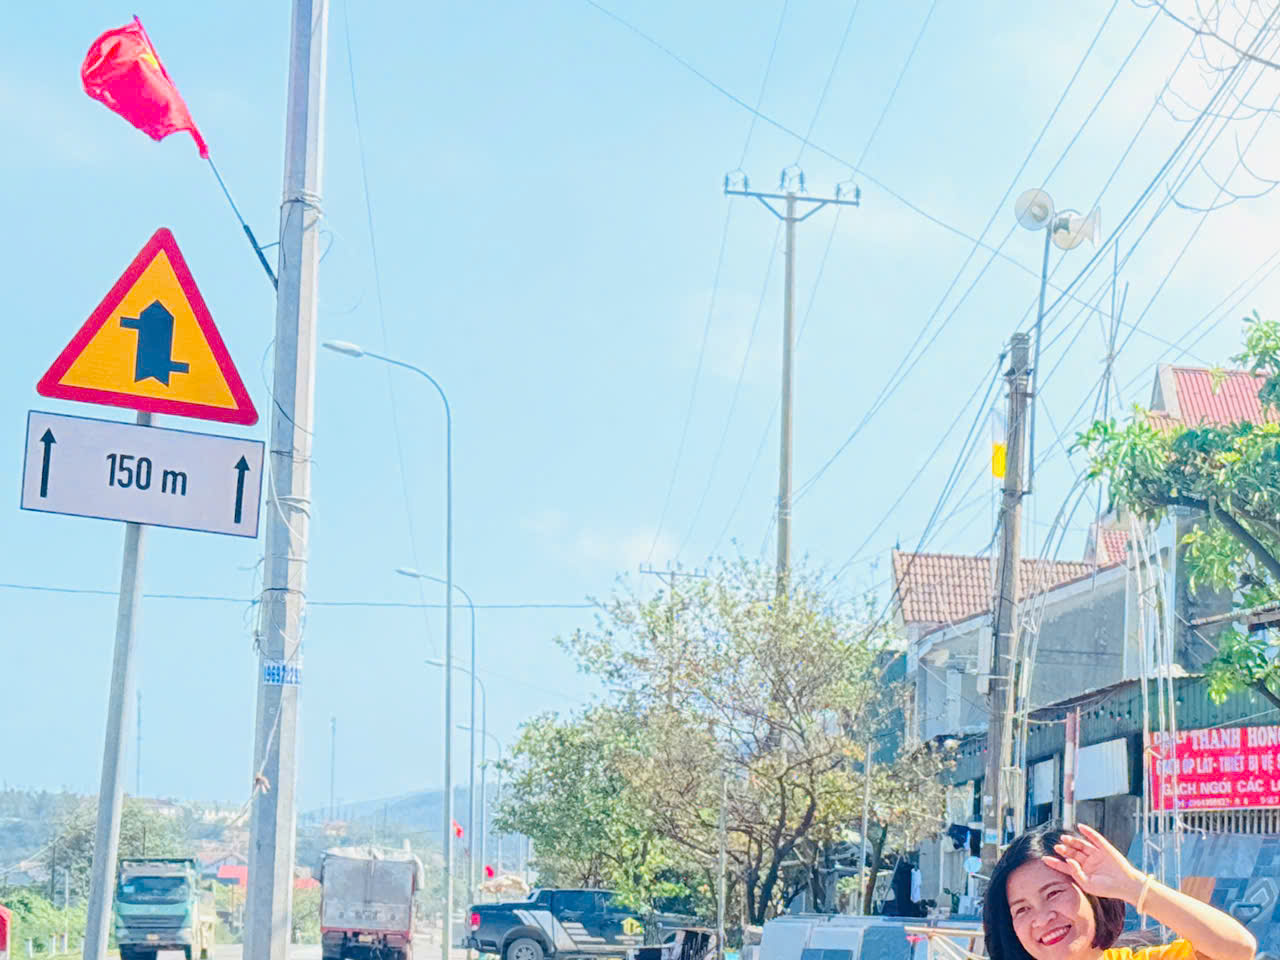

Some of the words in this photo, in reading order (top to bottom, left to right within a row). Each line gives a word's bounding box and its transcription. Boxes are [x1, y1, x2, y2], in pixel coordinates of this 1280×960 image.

[106, 453, 152, 491] 150
[161, 469, 187, 496] m
[1191, 728, 1241, 750] THANH
[1236, 776, 1265, 793] CÁC
